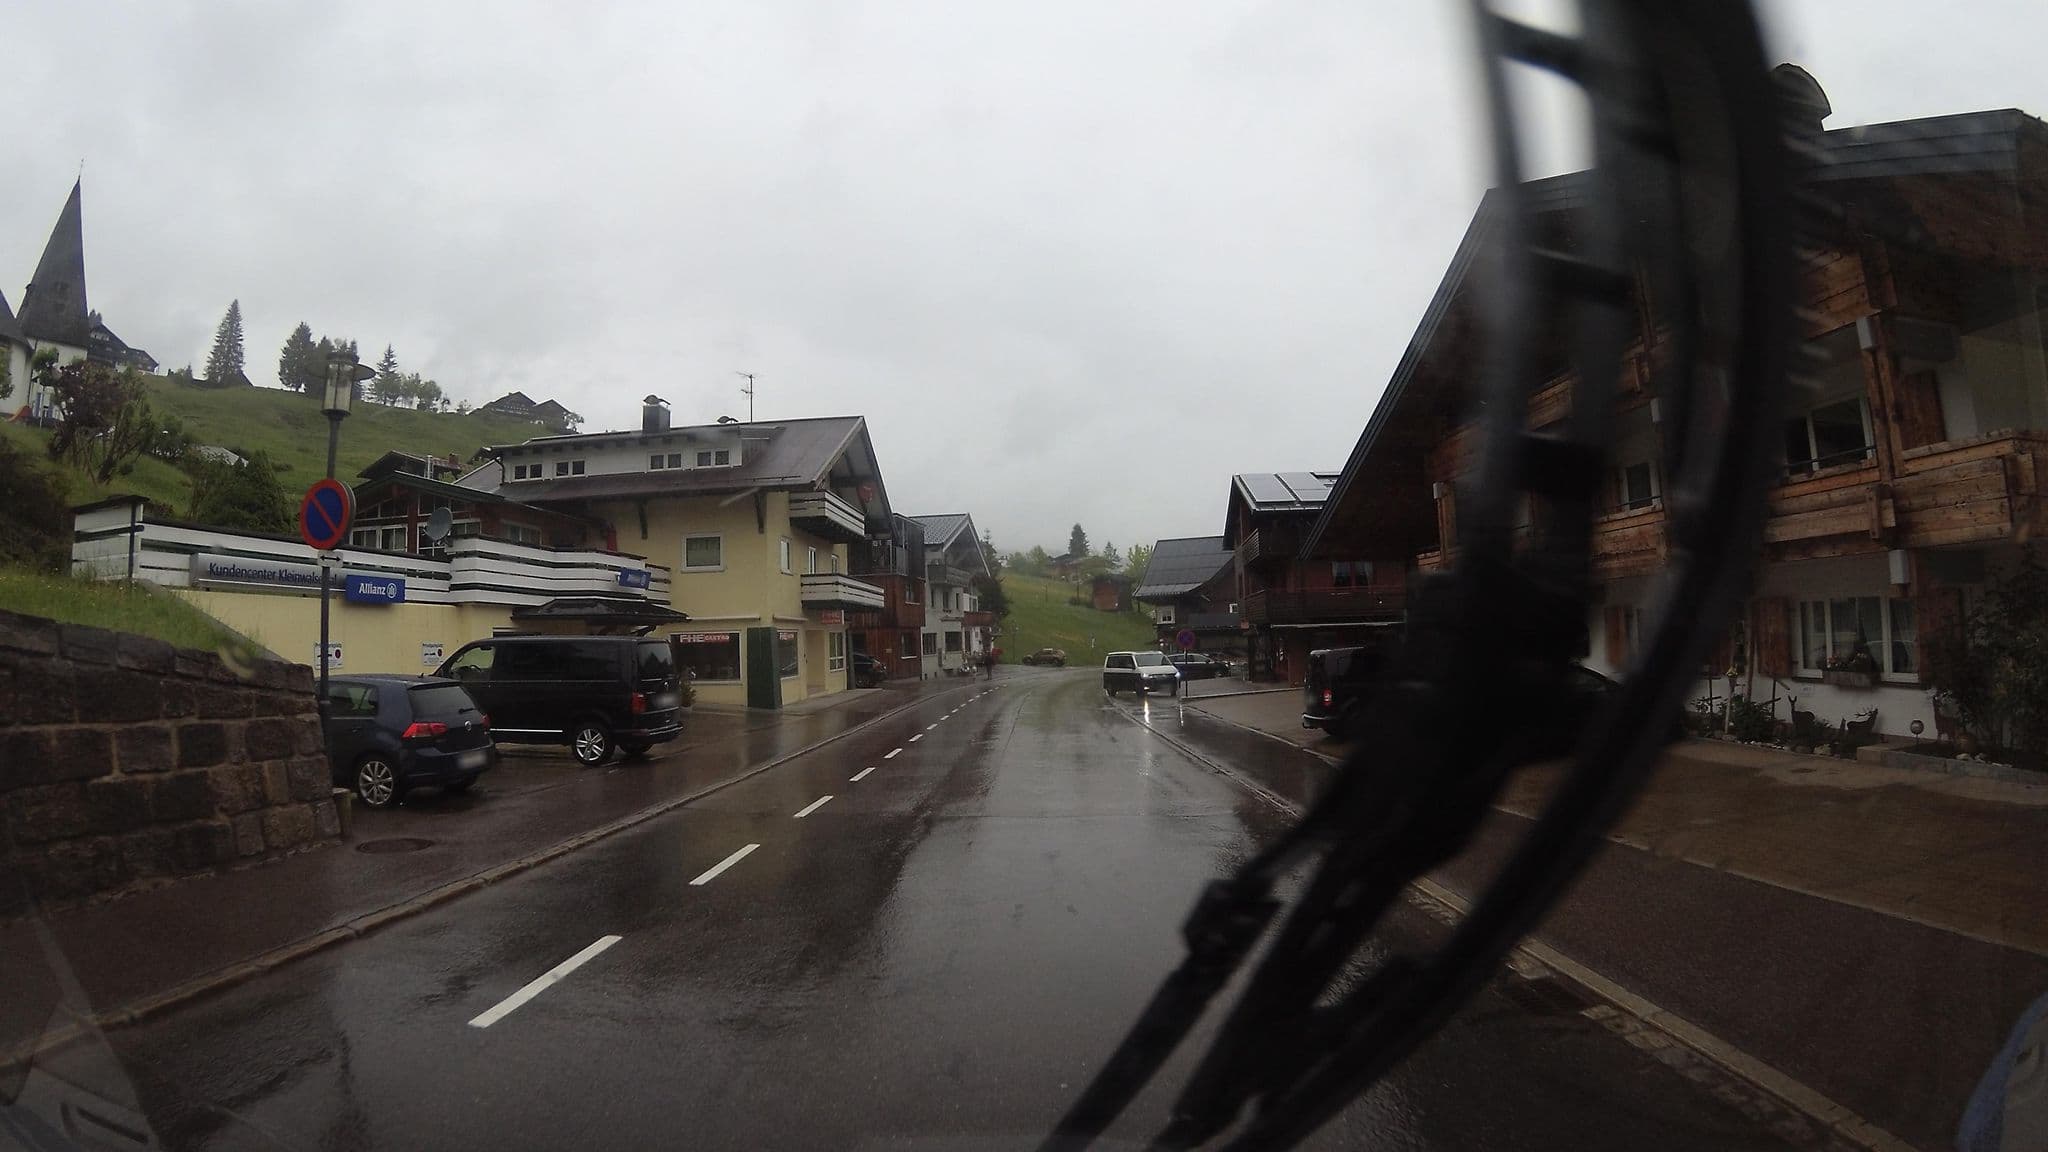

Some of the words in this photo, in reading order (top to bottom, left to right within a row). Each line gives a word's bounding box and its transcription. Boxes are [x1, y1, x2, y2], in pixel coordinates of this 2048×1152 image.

[208, 562, 276, 580] Kundencenter
[278, 568, 337, 586] Kleinwalseal
[358, 582, 386, 595] Allianz
